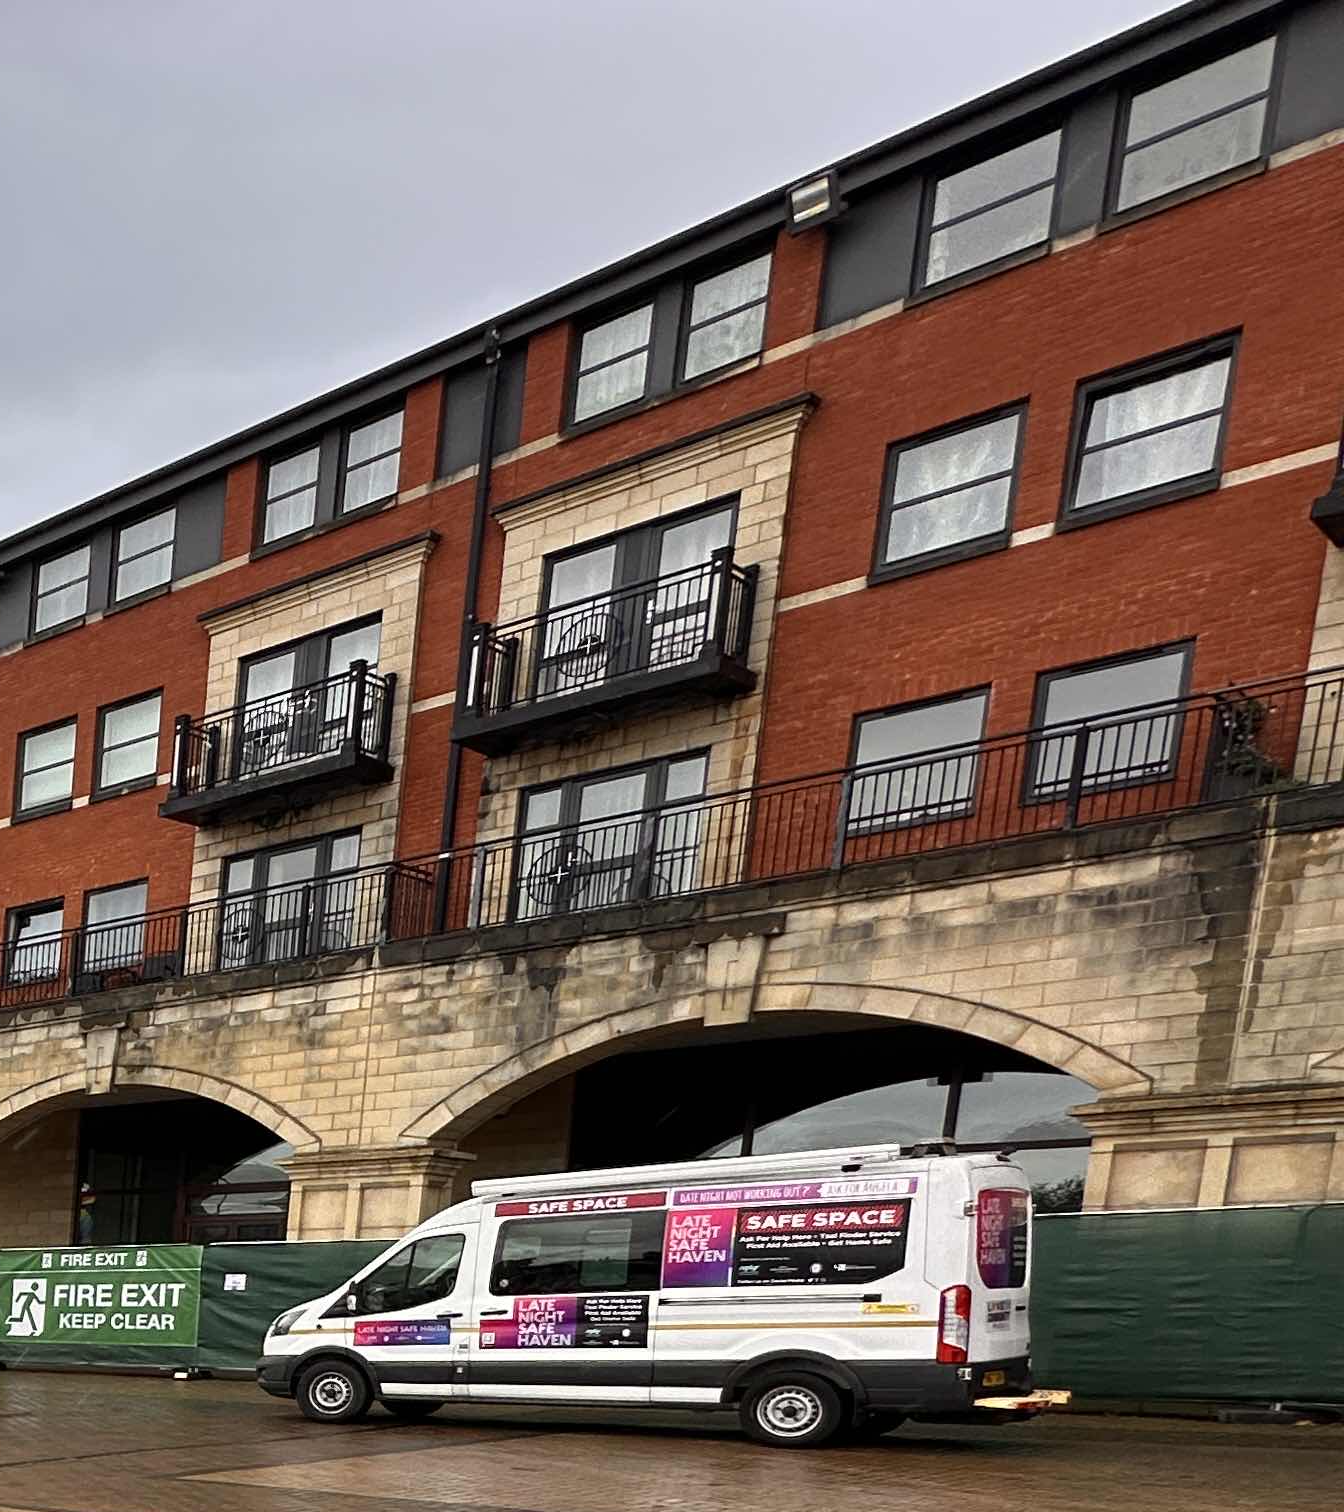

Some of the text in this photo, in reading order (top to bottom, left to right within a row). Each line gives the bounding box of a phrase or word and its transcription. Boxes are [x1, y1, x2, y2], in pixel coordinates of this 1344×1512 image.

[680, 1191, 699, 1203] DATE
[700, 1190, 726, 1202] NIGHT
[528, 1197, 628, 1215] SAFE SPACE
[671, 1214, 712, 1228] LATE
[747, 1208, 897, 1230] SAFE SPACE
[670, 1225, 721, 1240] NIGHT
[669, 1238, 710, 1251] SAFE
[60, 1253, 128, 1267] FIRE EXIT
[668, 1250, 726, 1263] HAVEN
[53, 1283, 186, 1308] FIRE EXIT
[518, 1299, 556, 1311] LATE
[59, 1313, 175, 1330] KEEP CLEAR
[518, 1310, 566, 1323] NIGHT
[517, 1322, 556, 1334] SAFE
[517, 1334, 572, 1347] HAVEN
